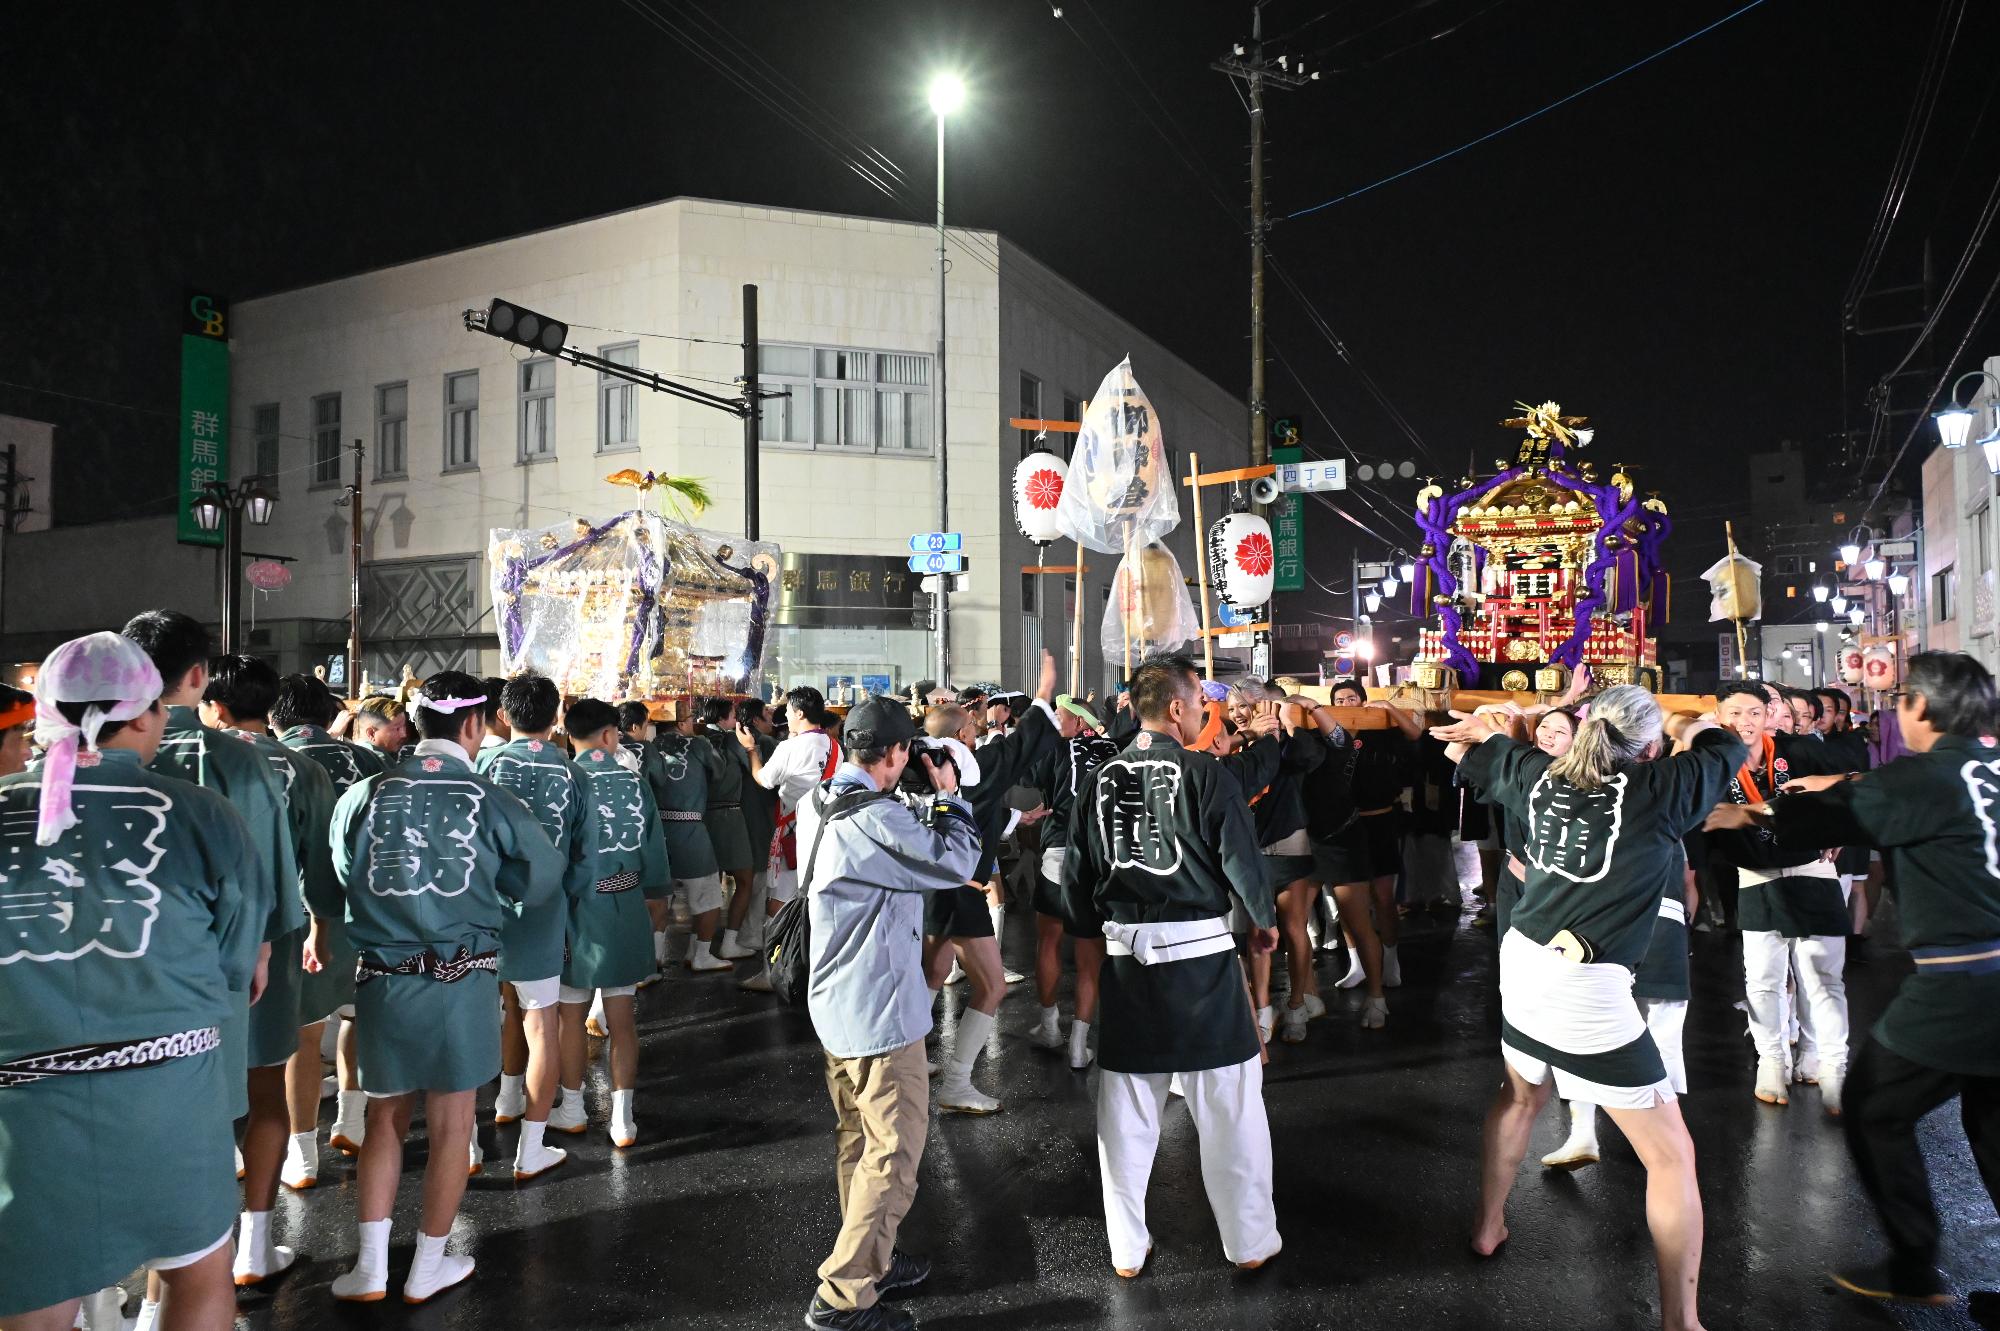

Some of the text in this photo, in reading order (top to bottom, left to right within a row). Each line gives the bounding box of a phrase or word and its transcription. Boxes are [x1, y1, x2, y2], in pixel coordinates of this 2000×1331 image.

[191, 410, 219, 520] 群馬銀
[1283, 466, 1337, 483] 四丁目
[929, 536, 943, 549] 23
[929, 557, 943, 569] 40
[783, 569, 906, 593] 群馬銀行
